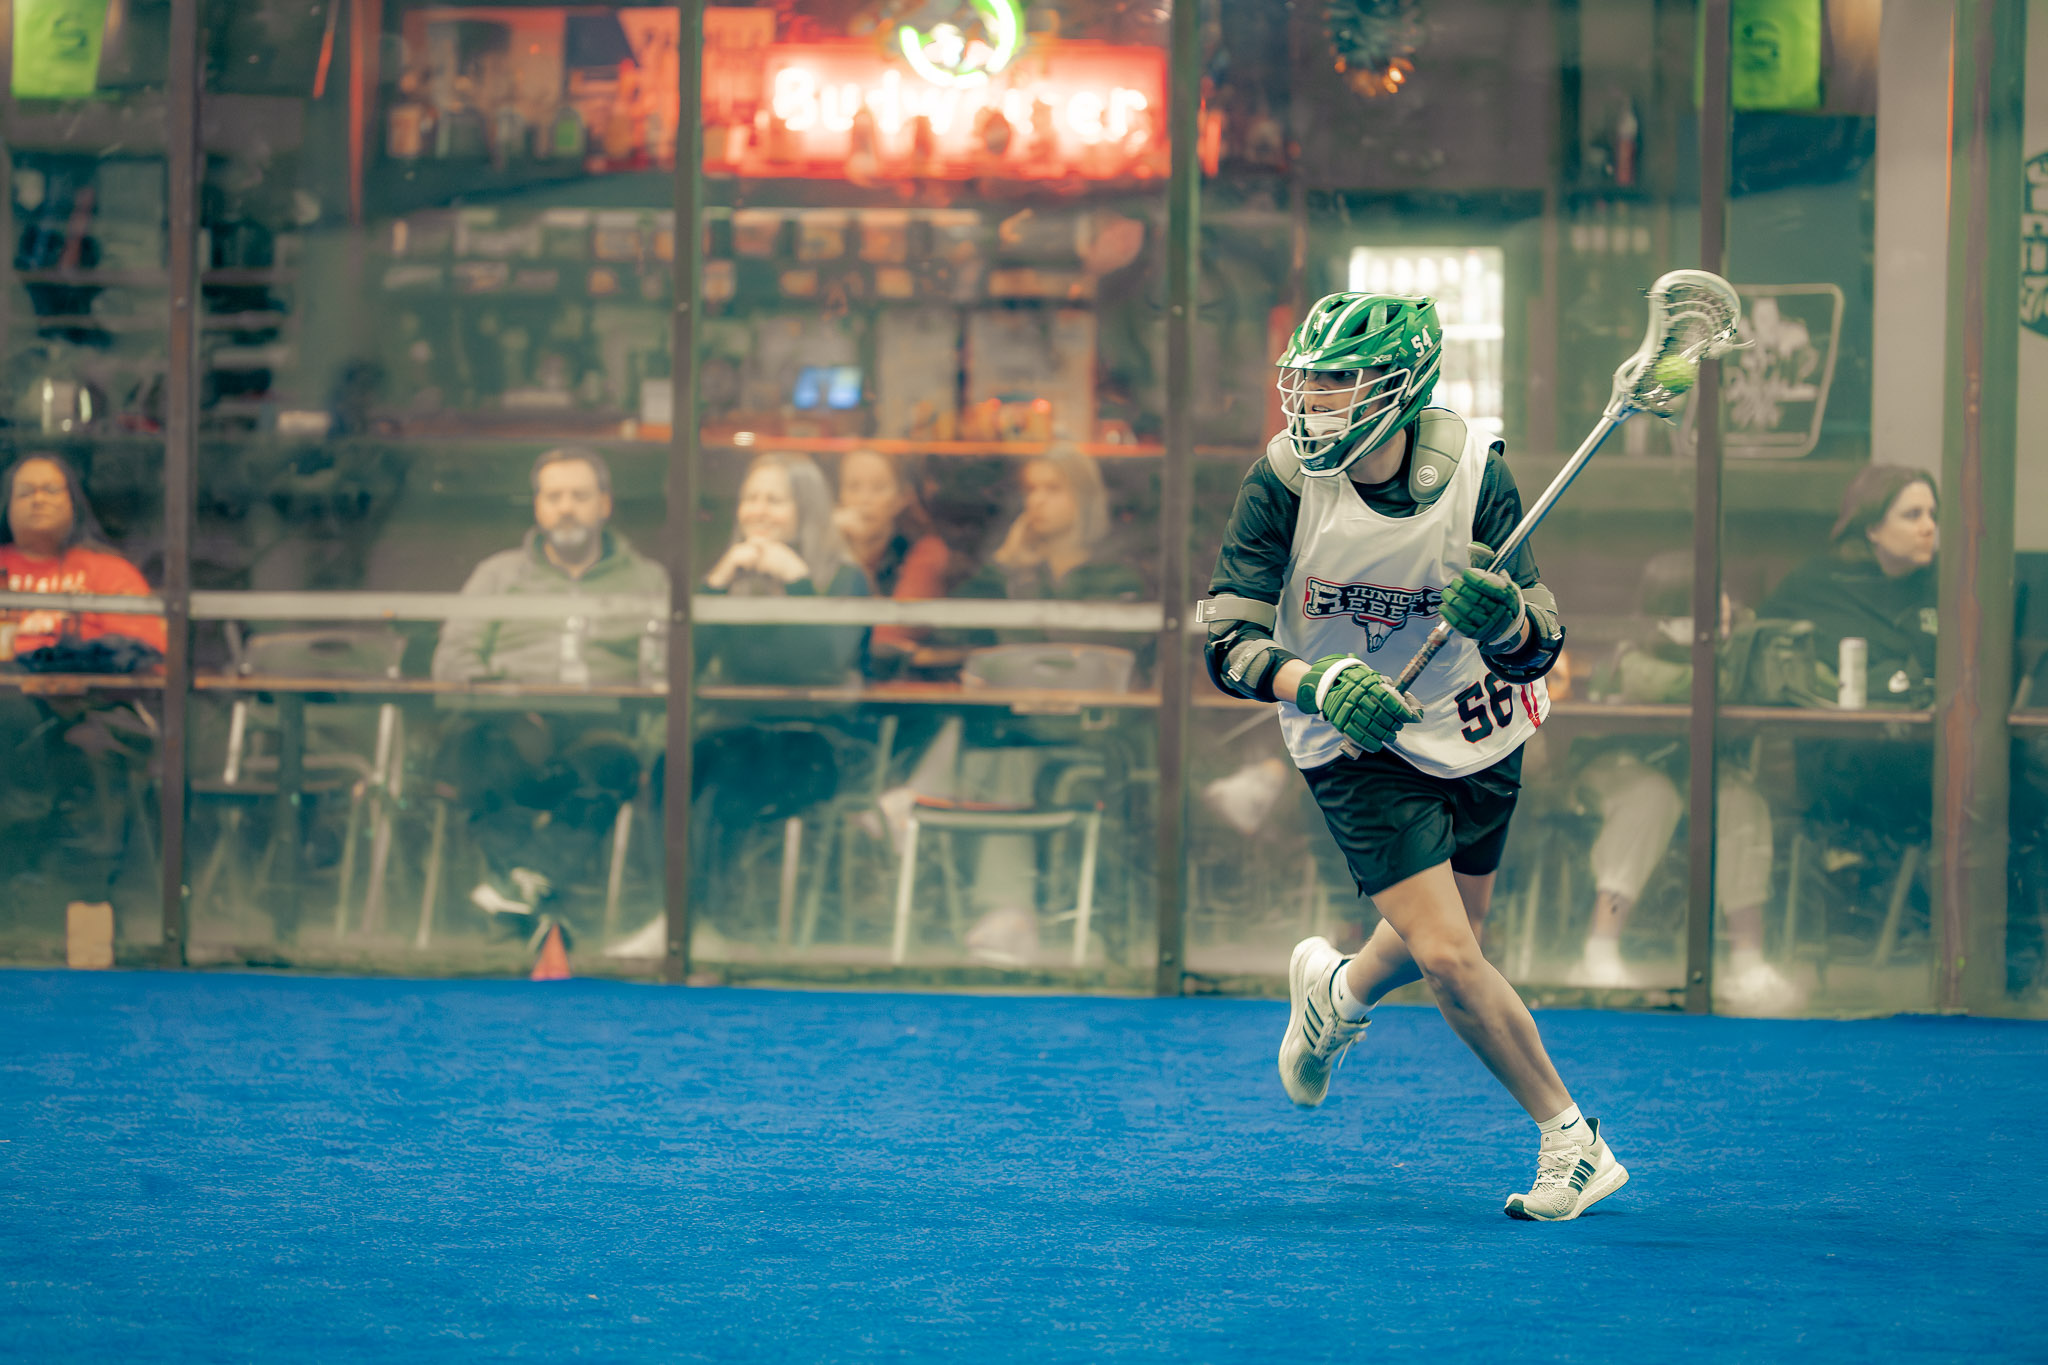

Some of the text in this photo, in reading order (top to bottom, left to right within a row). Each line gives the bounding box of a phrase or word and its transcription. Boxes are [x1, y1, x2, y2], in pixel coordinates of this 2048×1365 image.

[773, 67, 1147, 142] Budwier
[1411, 325, 1434, 358] 54
[1454, 671, 1514, 744] 56
